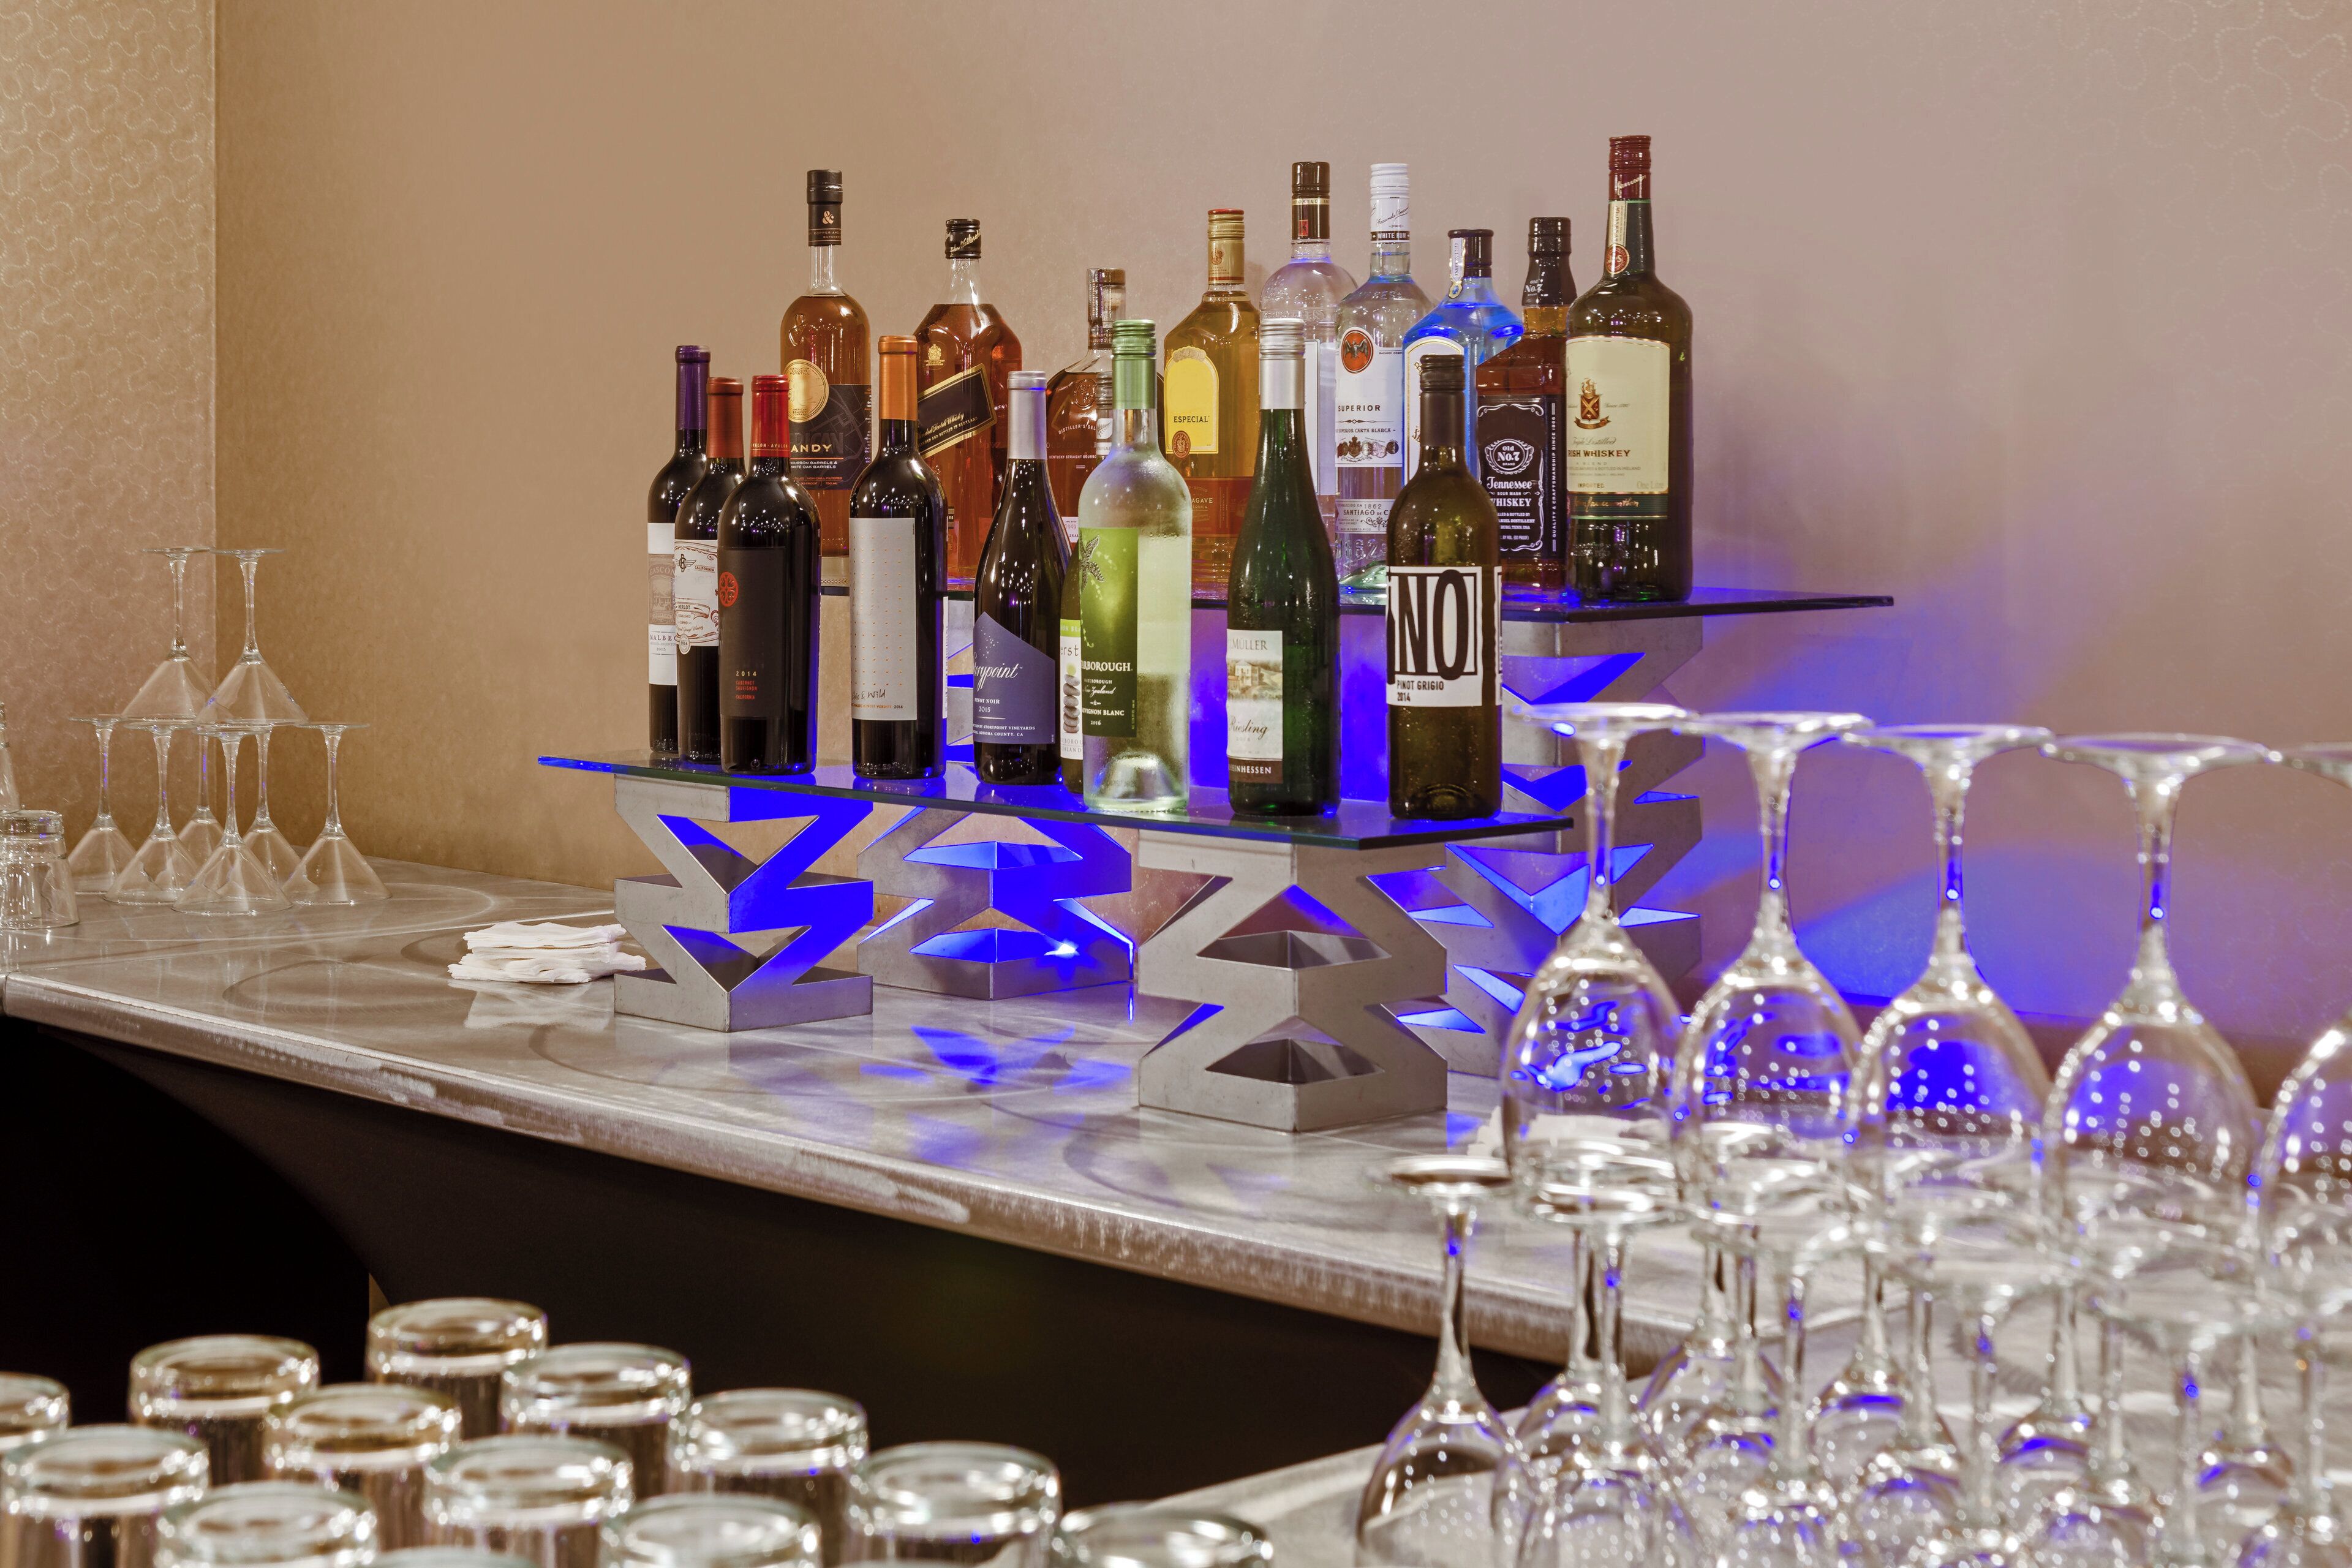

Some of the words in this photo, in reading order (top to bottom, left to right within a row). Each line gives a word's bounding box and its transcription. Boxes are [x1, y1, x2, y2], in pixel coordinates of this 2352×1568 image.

[938, 427, 954, 437] BOTTLED
[1058, 424, 1086, 435] DISTILLER'S
[790, 444, 832, 453] ANDY
[1497, 451, 1520, 462] No.7
[1487, 476, 1532, 489] Tennessee
[1396, 680, 1414, 690] PINOT
[1417, 680, 1444, 691] GRIGIO
[867, 688, 886, 698] Wild
[1396, 692, 1411, 702] 2014
